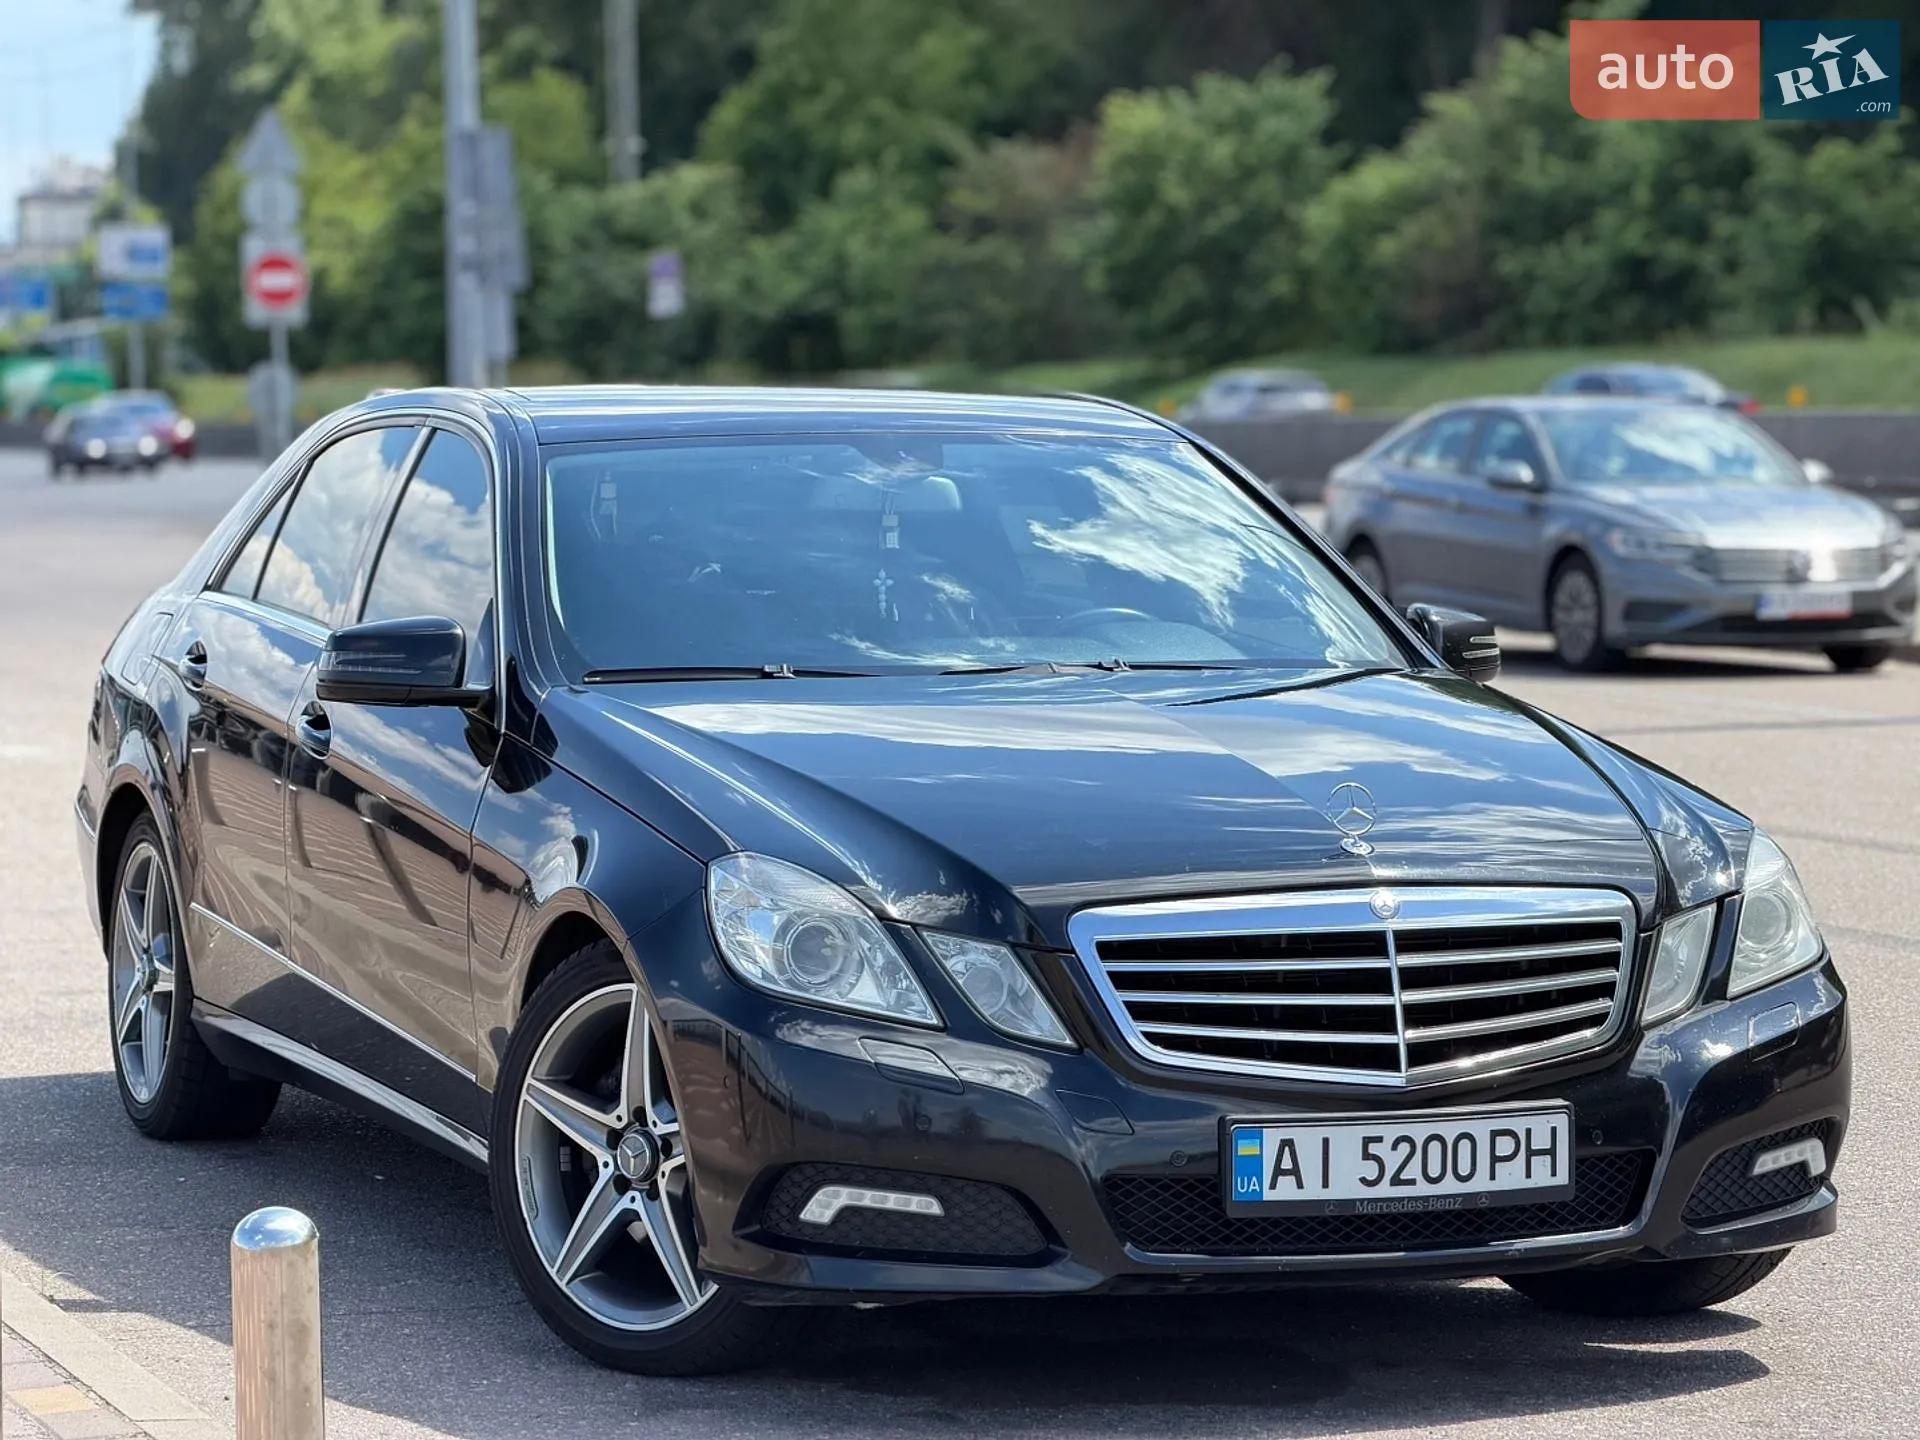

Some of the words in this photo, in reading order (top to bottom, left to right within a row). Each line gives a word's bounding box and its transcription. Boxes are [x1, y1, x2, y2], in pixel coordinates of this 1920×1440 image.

[1268, 1136, 1330, 1191] AI
[1237, 1176, 1260, 1193] UA
[1355, 1197, 1463, 1214] Mercedes-Benz
